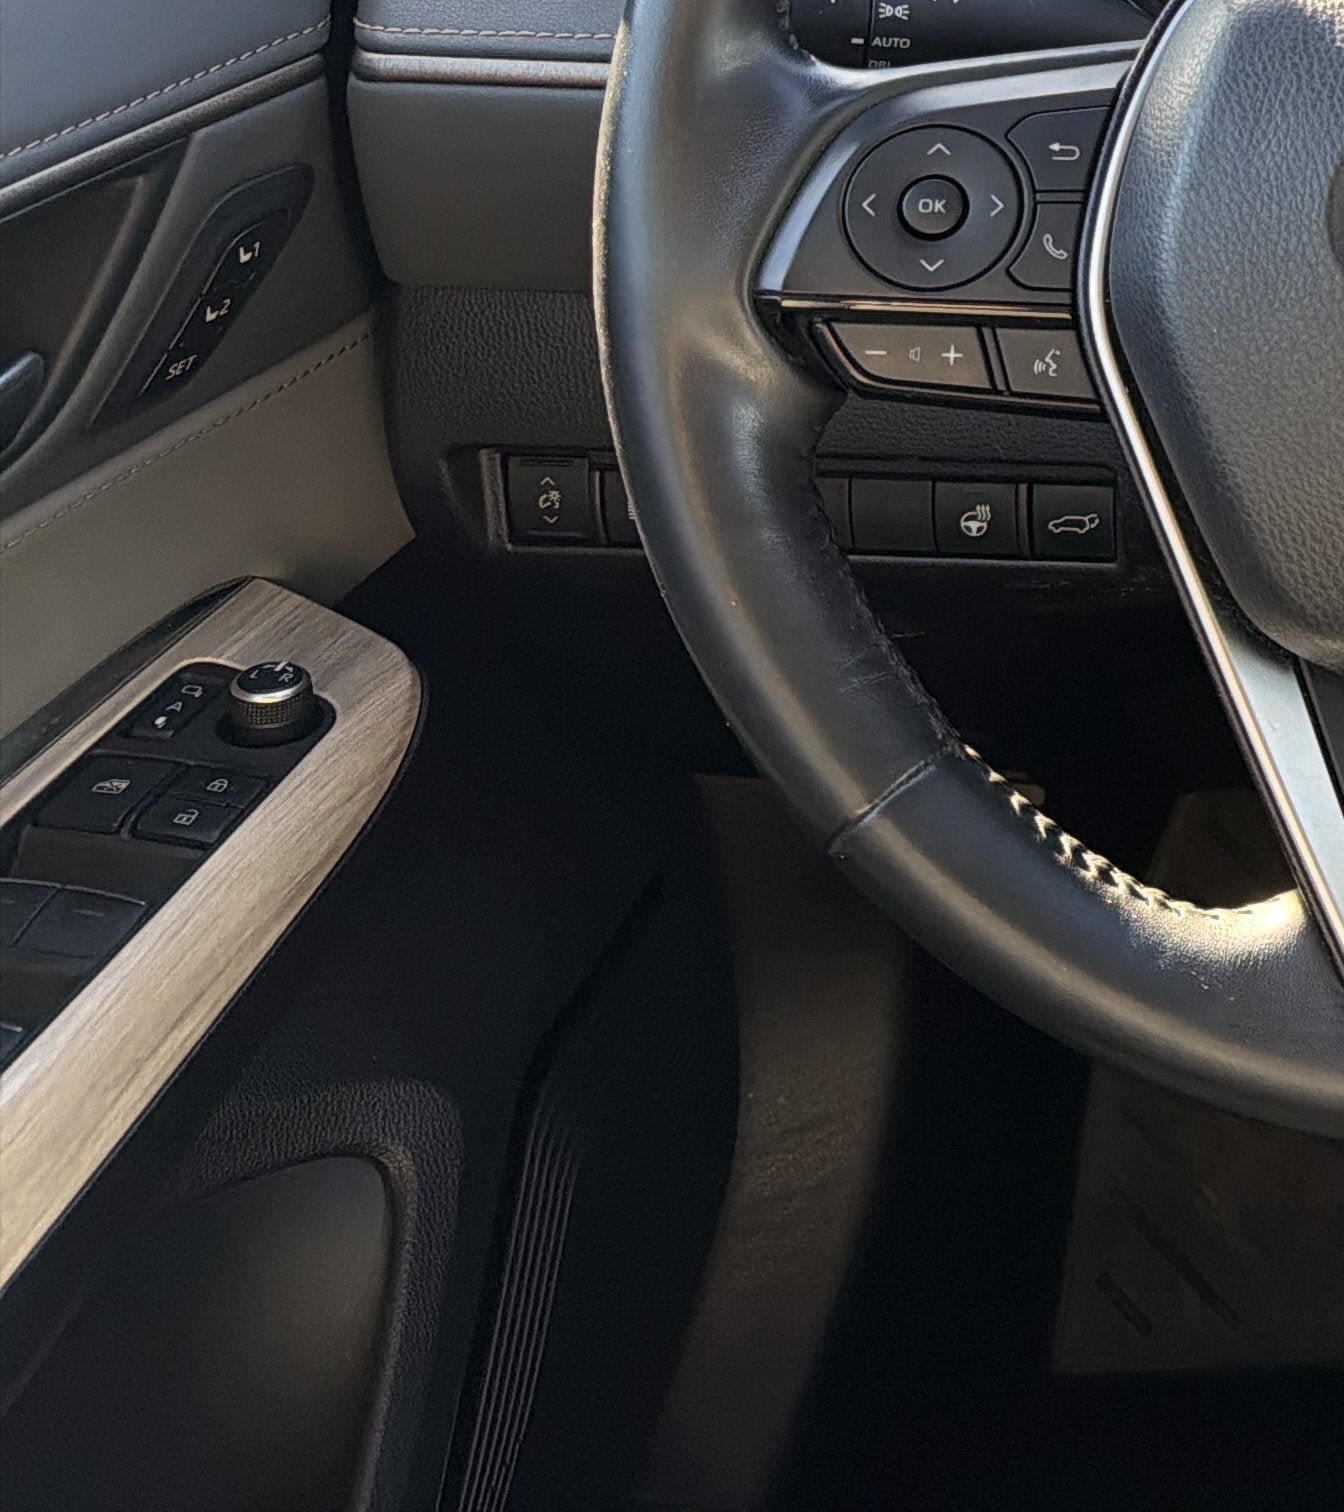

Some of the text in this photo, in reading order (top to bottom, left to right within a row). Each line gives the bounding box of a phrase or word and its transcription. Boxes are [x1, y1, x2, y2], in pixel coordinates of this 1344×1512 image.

[871, 37, 911, 49] AUTO
[918, 199, 946, 213] OK
[165, 354, 198, 381] SET
[278, 672, 295, 683] R
